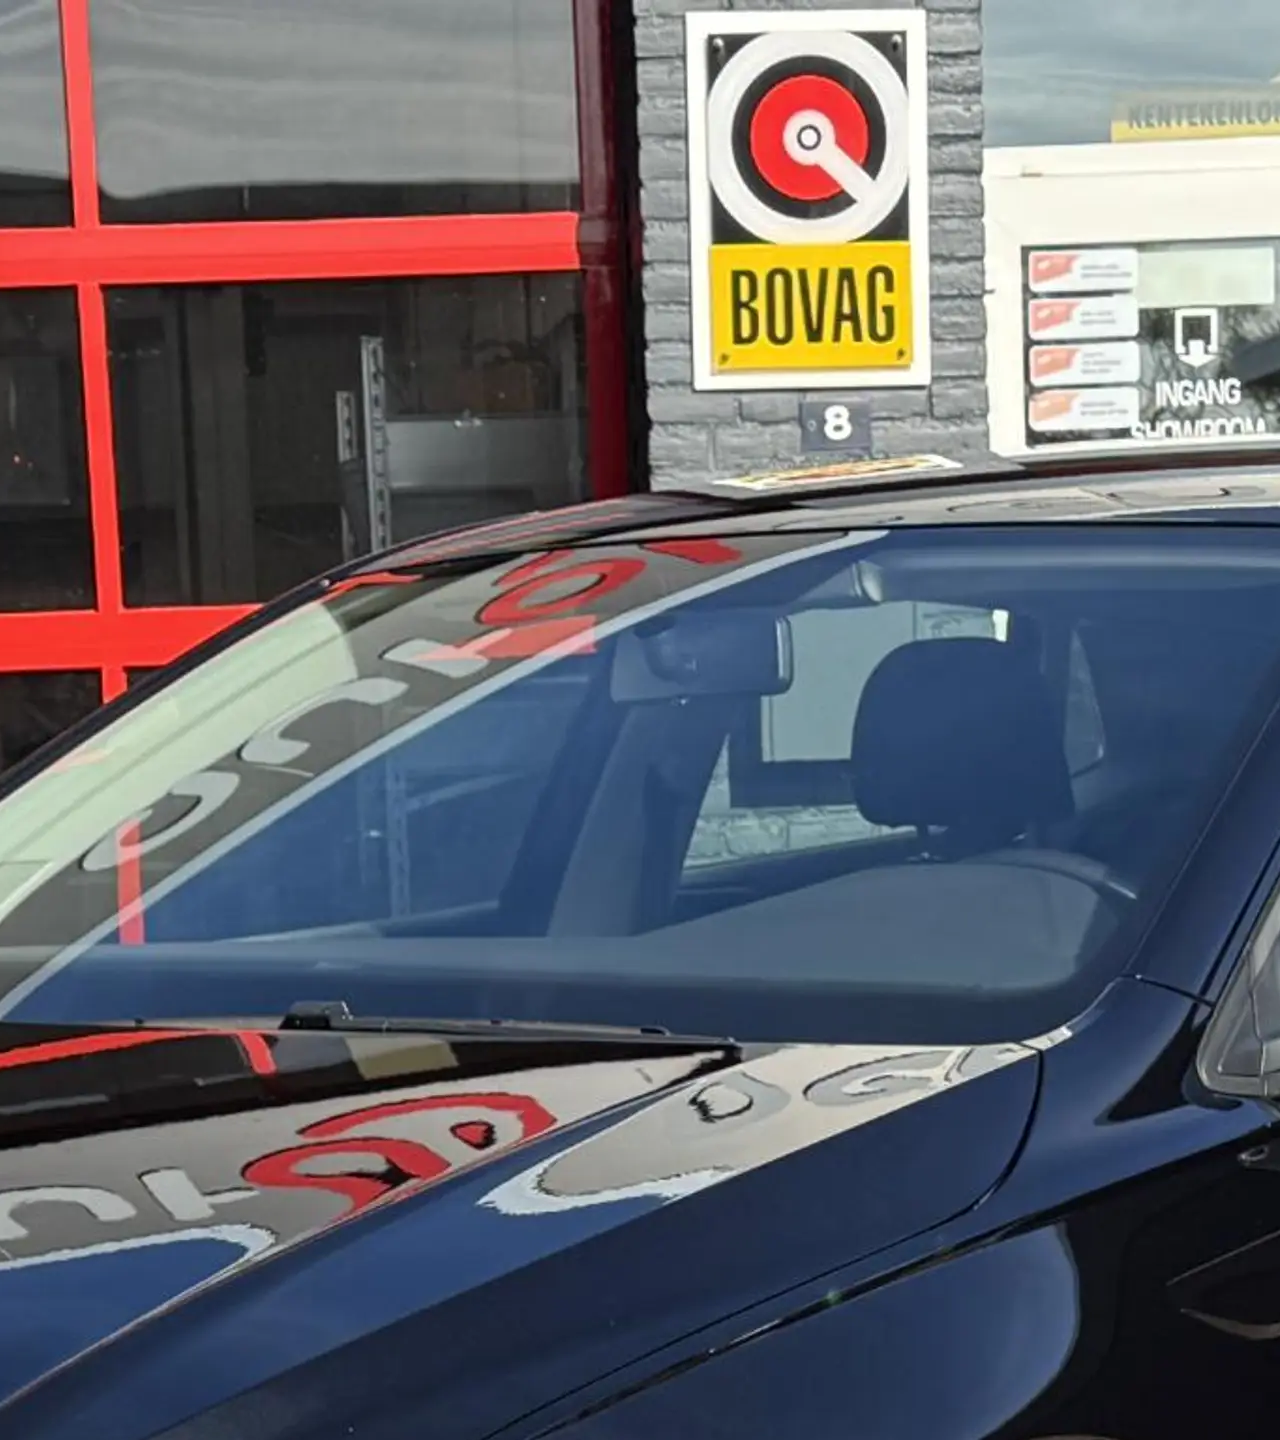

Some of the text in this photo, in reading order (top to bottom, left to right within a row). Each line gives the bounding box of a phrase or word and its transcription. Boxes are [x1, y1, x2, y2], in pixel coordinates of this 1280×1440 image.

[731, 264, 895, 345] BOVAG
[1155, 377, 1242, 407] INGANG
[823, 404, 852, 440] 8
[1130, 416, 1267, 438] SHOWROOM
